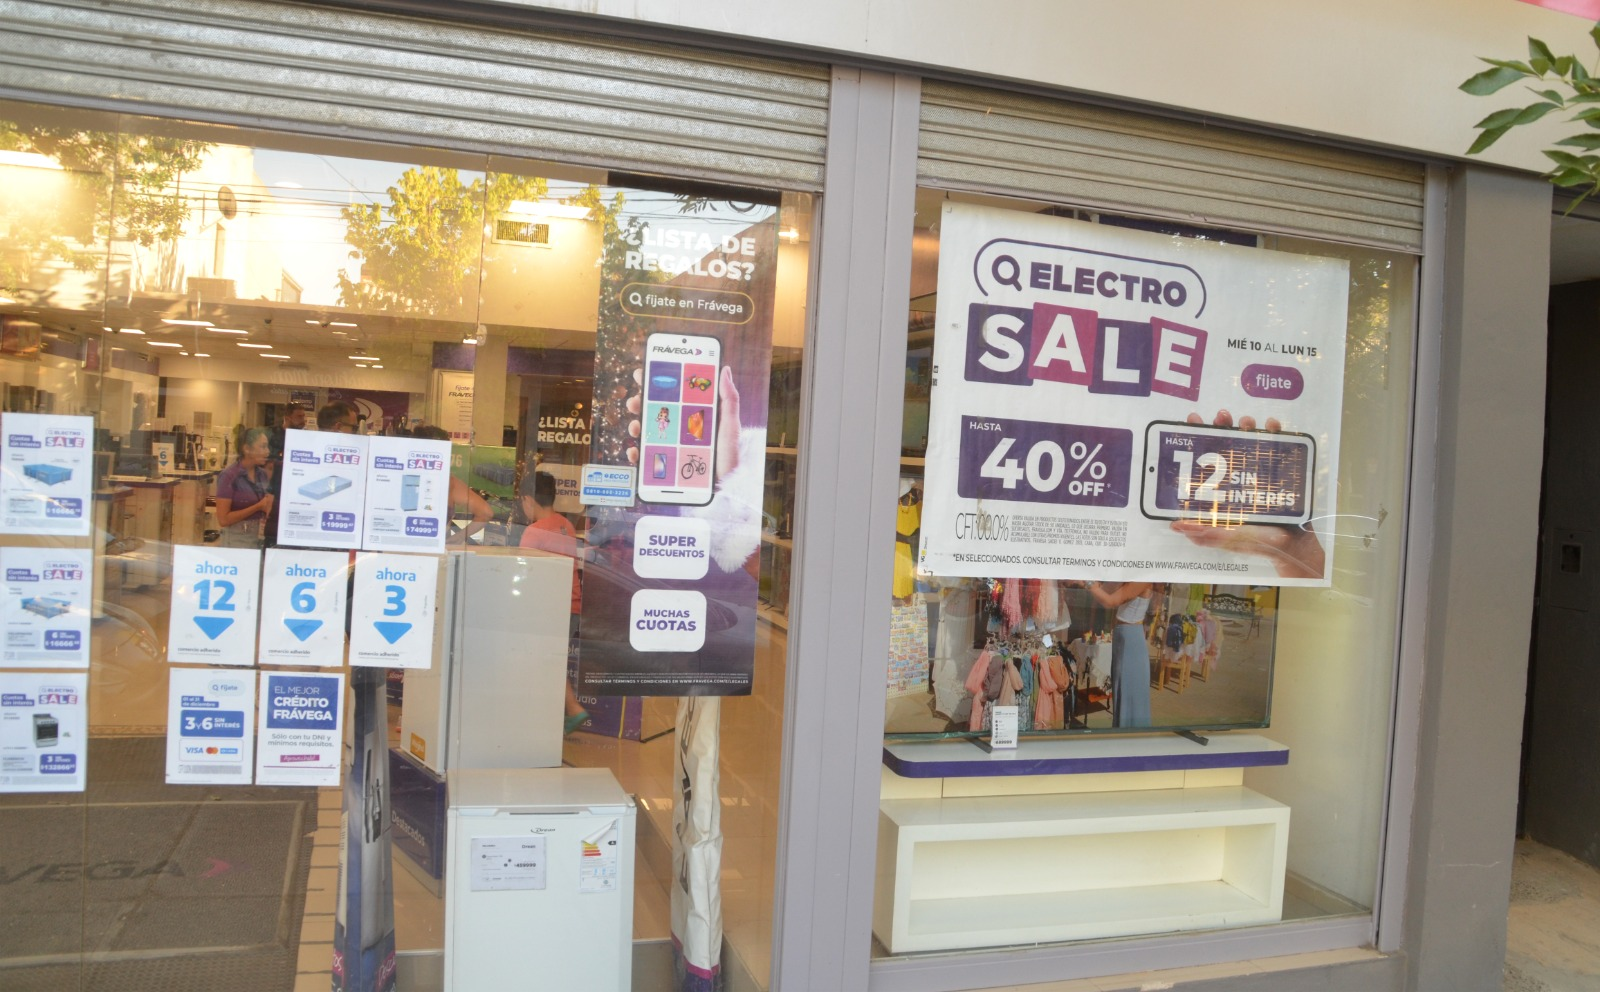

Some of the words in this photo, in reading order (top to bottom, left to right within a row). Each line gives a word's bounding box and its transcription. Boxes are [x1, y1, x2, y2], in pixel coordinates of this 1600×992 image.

[626, 227, 713, 251] ¿LISTA
[721, 235, 756, 257] DE
[624, 250, 755, 281] REGALOS?
[1029, 260, 1188, 308] ELECTRO
[679, 299, 694, 308] en
[697, 299, 743, 315] Frávega
[652, 345, 694, 355] FRÁVEGA
[978, 312, 1198, 389] SALE
[1227, 337, 1248, 351] MIÉ
[1250, 340, 1262, 351] 10
[1264, 341, 1279, 353] AL
[1281, 343, 1305, 356] LUN
[1306, 345, 1317, 357] 15
[1255, 373, 1292, 390] fijate
[969, 421, 1002, 432] HASTA
[46, 436, 84, 447] SALE
[1165, 437, 1194, 447] HASTA
[325, 454, 359, 465] SALE
[409, 459, 442, 470] SALE
[980, 437, 1107, 493] 40%
[1173, 449, 1228, 502] 12
[1230, 471, 1257, 485] SIN
[1229, 488, 1295, 507] INTERÉS
[649, 535, 697, 547] SUPER
[639, 548, 705, 559] DESCUENTOS
[195, 561, 238, 576] ahora
[285, 564, 327, 578] ahora
[1022, 556, 1060, 565] CONSULTAR
[1062, 557, 1096, 567] TERMINOS
[1102, 560, 1145, 569] CONDICIONES
[1145, 561, 1154, 569] EN
[1155, 561, 1249, 572] WWW.FRAVEGA.COM/E/LEGALES
[44, 569, 82, 580] SALE
[376, 568, 416, 582] ahora
[192, 579, 236, 612] 12
[290, 581, 316, 614] 6
[383, 584, 407, 617] 3
[644, 608, 690, 619] MUCHAS
[636, 619, 697, 632] CUOTAS
[275, 686, 285, 694] EL
[287, 686, 320, 695] MEJOR
[40, 694, 77, 704] SALE
[274, 695, 329, 708] CRÉDITO
[273, 708, 333, 721] FRÁVEGA
[185, 716, 196, 730] 3
[201, 717, 213, 731] 6
[0, 859, 186, 885] VEGA
